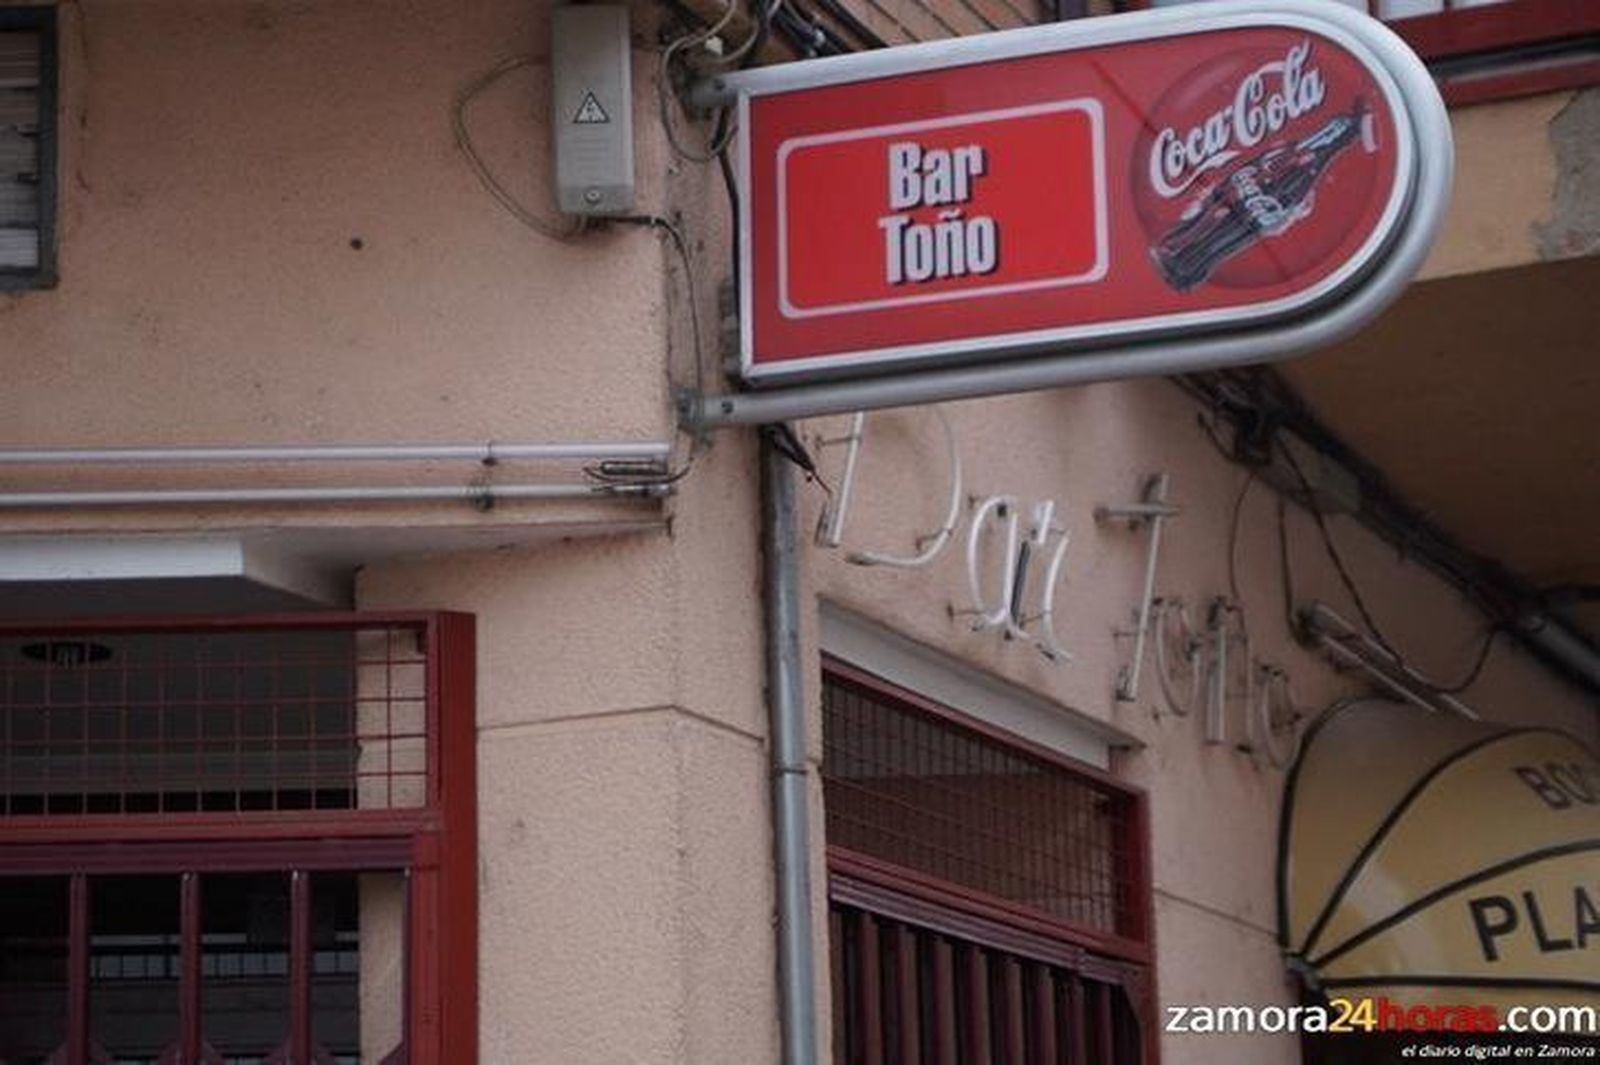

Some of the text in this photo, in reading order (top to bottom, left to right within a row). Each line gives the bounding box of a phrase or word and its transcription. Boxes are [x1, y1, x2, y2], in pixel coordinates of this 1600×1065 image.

[1150, 39, 1326, 197] Coca-Cola
[888, 140, 986, 211] Bar
[878, 208, 997, 286] Toño
[1468, 886, 1600, 962] PLA
